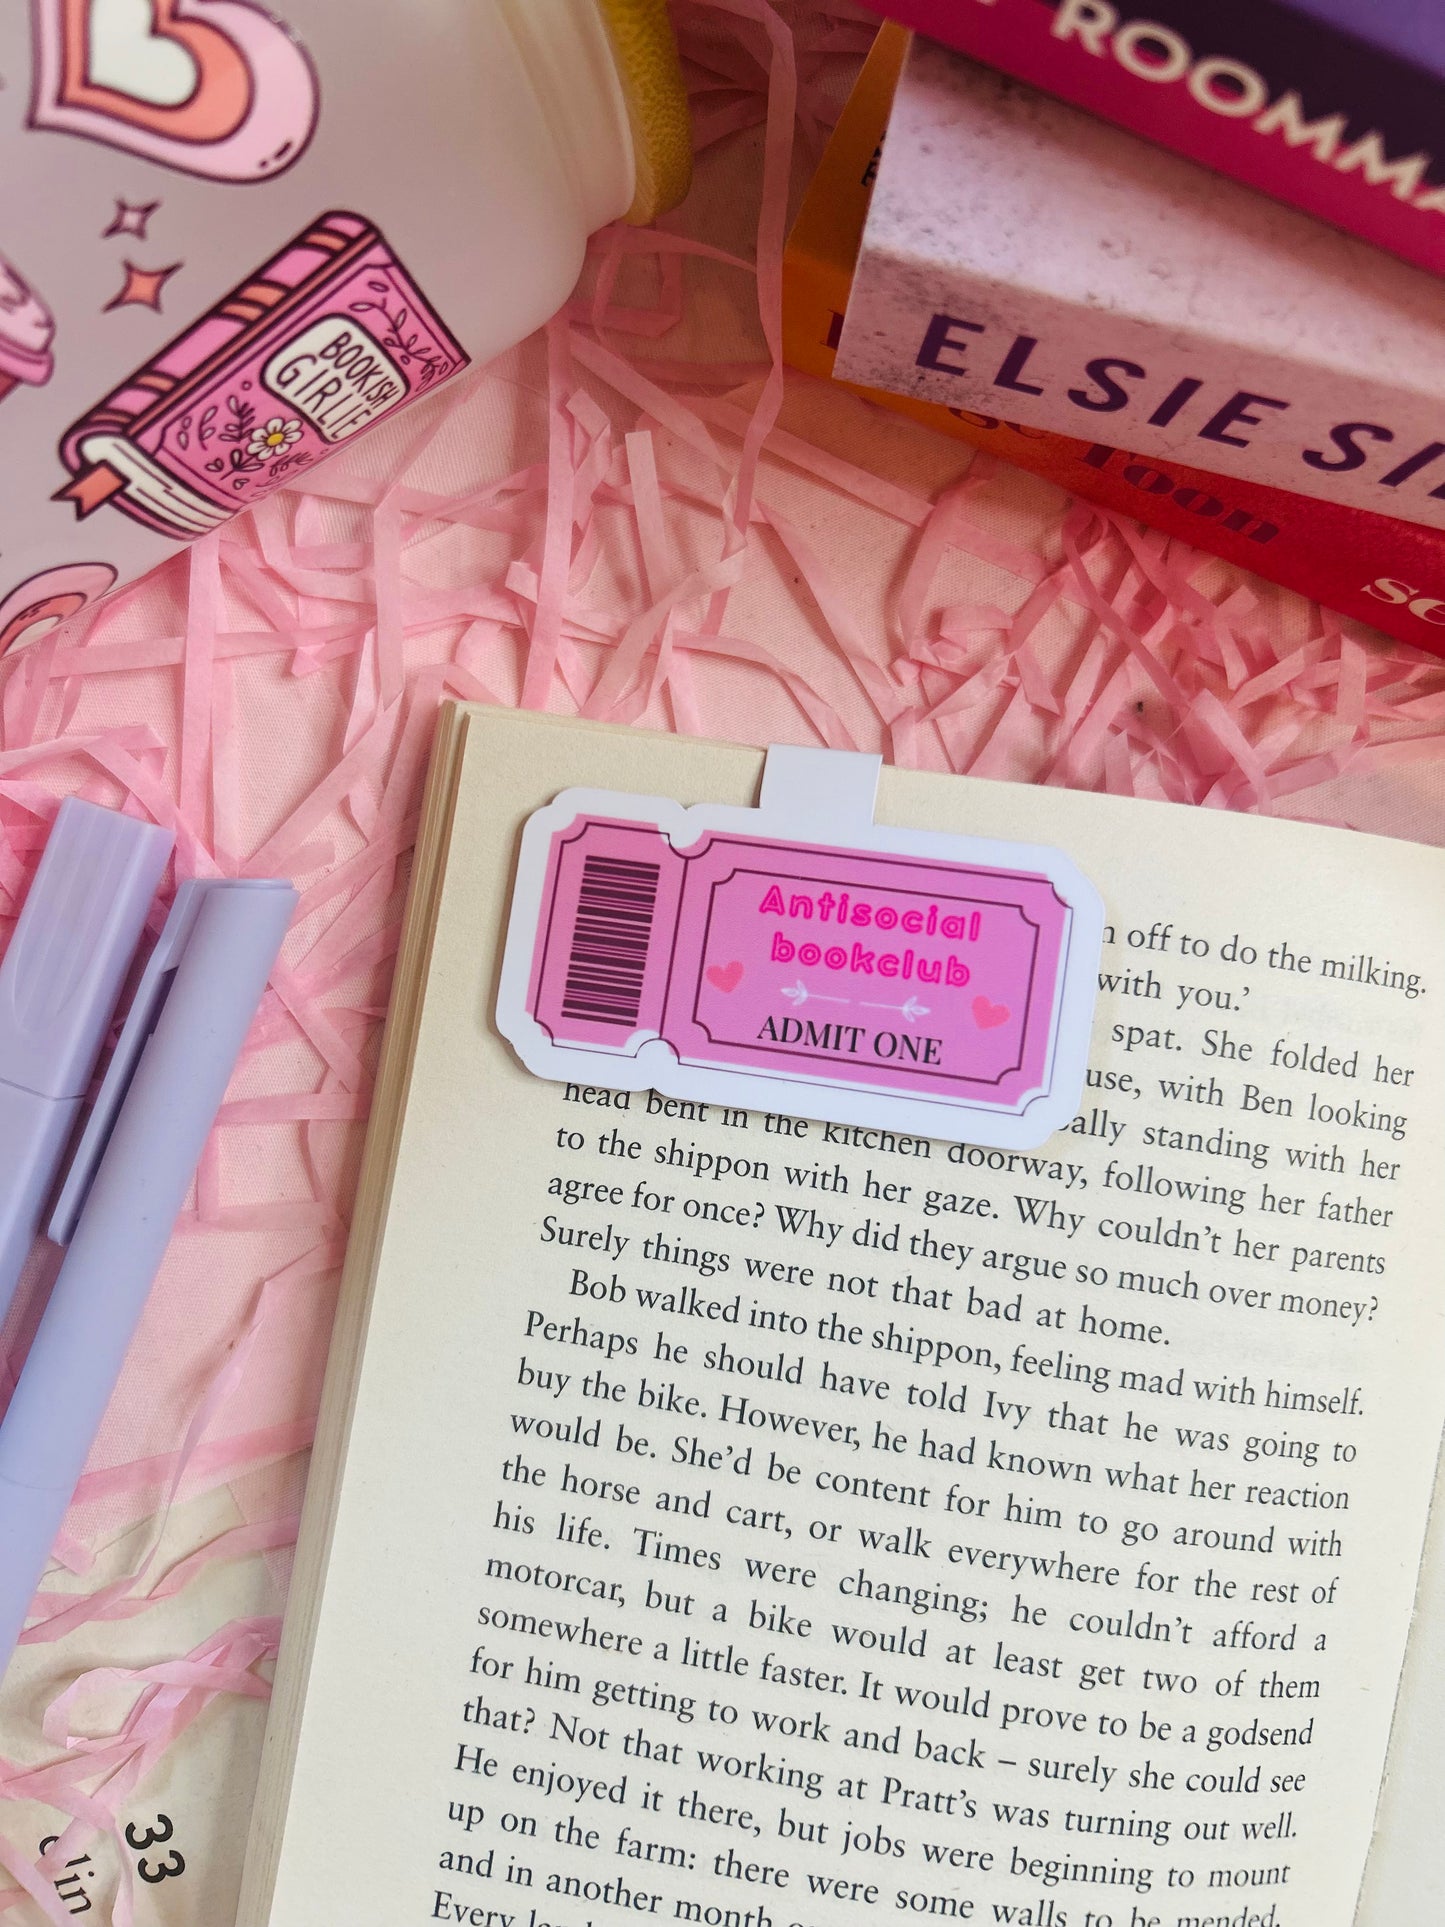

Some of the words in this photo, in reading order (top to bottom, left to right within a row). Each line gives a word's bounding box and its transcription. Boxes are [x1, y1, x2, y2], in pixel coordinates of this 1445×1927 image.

[275, 353, 373, 440] GIRLIE
[318, 331, 401, 411] BOOKISH
[914, 312, 1291, 451] ELSIE
[758, 884, 982, 942] Antisocial
[770, 930, 971, 988] bookclub
[1126, 922, 1174, 952] off
[1179, 933, 1210, 958] to
[1219, 933, 1258, 965] do
[1267, 941, 1312, 974] the
[1319, 954, 1426, 1000] milking.
[756, 1014, 867, 1054] ADMIT
[872, 1030, 944, 1066] ONE
[1098, 968, 1162, 1000] with
[1175, 984, 1250, 1012] you.’
[1086, 1068, 1142, 1100] use,
[1157, 1075, 1224, 1107] with
[1239, 1083, 1293, 1118] Ben
[1307, 1092, 1408, 1142] looking
[1111, 1024, 1182, 1053] spat.
[1201, 1029, 1253, 1062] She
[1269, 1038, 1359, 1079] folded
[1372, 1054, 1415, 1088] her
[556, 1127, 585, 1151] to
[597, 1127, 642, 1160] the
[653, 1137, 770, 1182] shippon
[783, 1162, 849, 1195] with
[861, 1169, 913, 1205] her
[922, 1190, 999, 1220] gaze.
[1012, 1194, 1086, 1239] Why
[1097, 1216, 1222, 1254] couldn’t
[1232, 1227, 1281, 1262] her
[1289, 1246, 1386, 1275] parents
[645, 1087, 710, 1124] bent
[763, 1111, 810, 1140] the
[947, 1146, 1088, 1190] doorway,
[1101, 1159, 1247, 1216] following
[1258, 1182, 1306, 1216] her
[1316, 1191, 1394, 1228] father
[1057, 1107, 1128, 1147] ally
[1142, 1125, 1271, 1170] standing
[1284, 1143, 1345, 1174] with
[1359, 1148, 1401, 1181] her
[540, 1215, 631, 1262] Surely
[642, 1231, 730, 1278] things
[744, 1257, 815, 1287] were
[826, 1272, 880, 1298] not
[891, 1274, 954, 1311] that
[966, 1285, 1023, 1323] bad
[1035, 1307, 1067, 1330] at
[1077, 1303, 1170, 1346] home.
[547, 1177, 624, 1206] agree
[630, 1180, 676, 1214] for
[682, 1199, 765, 1229] once?
[773, 1204, 845, 1249] Why
[851, 1218, 901, 1252] did
[909, 1228, 975, 1271] they
[981, 1249, 1067, 1281] argue
[1075, 1264, 1109, 1286] so
[1115, 1269, 1200, 1301] much
[1208, 1284, 1272, 1310] over
[1277, 1293, 1379, 1328] money?
[568, 1268, 627, 1304] Bob
[635, 1285, 741, 1324] walked
[747, 1299, 808, 1336] into
[817, 1311, 864, 1346] the
[871, 1321, 1002, 1376] shippon,
[1009, 1343, 1112, 1394] feeling
[1117, 1367, 1185, 1397] mad
[1192, 1375, 1256, 1406] with
[1263, 1378, 1364, 1416] himself.
[509, 1414, 602, 1448] would
[615, 1423, 656, 1459] be.
[671, 1435, 753, 1476] She’d
[767, 1450, 802, 1485] be
[815, 1471, 931, 1508] content
[943, 1483, 991, 1518] for
[1003, 1492, 1062, 1529] him
[1078, 1511, 1108, 1535] to
[1120, 1520, 1159, 1547] go
[1172, 1524, 1275, 1554] around
[1287, 1528, 1342, 1557] with
[517, 1355, 572, 1399] buy
[582, 1369, 627, 1403] the
[637, 1377, 707, 1419] bike.
[717, 1393, 861, 1452] However,
[871, 1419, 908, 1454] he
[917, 1427, 976, 1465] had
[986, 1439, 1092, 1484] known
[1104, 1460, 1180, 1495] what
[1187, 1468, 1236, 1501] her
[1244, 1481, 1349, 1510] reaction
[484, 1558, 626, 1609] motorcar,
[644, 1578, 696, 1617] but
[711, 1603, 728, 1623] a
[748, 1598, 813, 1638] bike
[831, 1624, 928, 1658] would
[945, 1644, 977, 1666] at
[992, 1640, 1064, 1679] least
[1078, 1663, 1126, 1691] get
[1143, 1668, 1198, 1694] two
[1214, 1668, 1248, 1697] of
[1259, 1670, 1320, 1699] them
[492, 1499, 535, 1535] his
[555, 1511, 610, 1550] life.
[633, 1526, 721, 1571] Times
[744, 1557, 817, 1589] were
[838, 1567, 988, 1624] changing;
[1010, 1593, 1047, 1627] he
[1069, 1608, 1193, 1645] couldn’t
[1212, 1619, 1297, 1652] afford
[1313, 1633, 1327, 1652] a
[463, 1694, 536, 1735] that?
[548, 1711, 610, 1751] Not
[623, 1727, 684, 1766] that
[696, 1750, 825, 1800] working
[837, 1778, 869, 1801] at
[880, 1775, 977, 1819] Pratt’s
[992, 1803, 1050, 1829] was
[1064, 1809, 1172, 1847] turning
[1183, 1820, 1231, 1841] out
[1241, 1810, 1297, 1841] well.
[469, 1645, 515, 1680] for
[523, 1655, 581, 1695] him
[591, 1679, 697, 1724] getting
[708, 1699, 739, 1725] to
[751, 1710, 832, 1743] work
[843, 1724, 901, 1755] and
[914, 1728, 987, 1769] back
[1027, 1754, 1119, 1793] surely
[1128, 1759, 1175, 1791] she
[1185, 1764, 1262, 1794] could
[1269, 1773, 1306, 1794] see
[124, 1813, 186, 1884] 33
[448, 1801, 485, 1833] up
[500, 1812, 537, 1838] on
[554, 1815, 600, 1850] the
[614, 1826, 696, 1871] farm:
[713, 1847, 790, 1889] there
[806, 1874, 879, 1905] were
[895, 1890, 975, 1920] some
[991, 1898, 1068, 1927] walls
[1084, 1911, 1113, 1927] to
[1130, 1905, 1161, 1927] be
